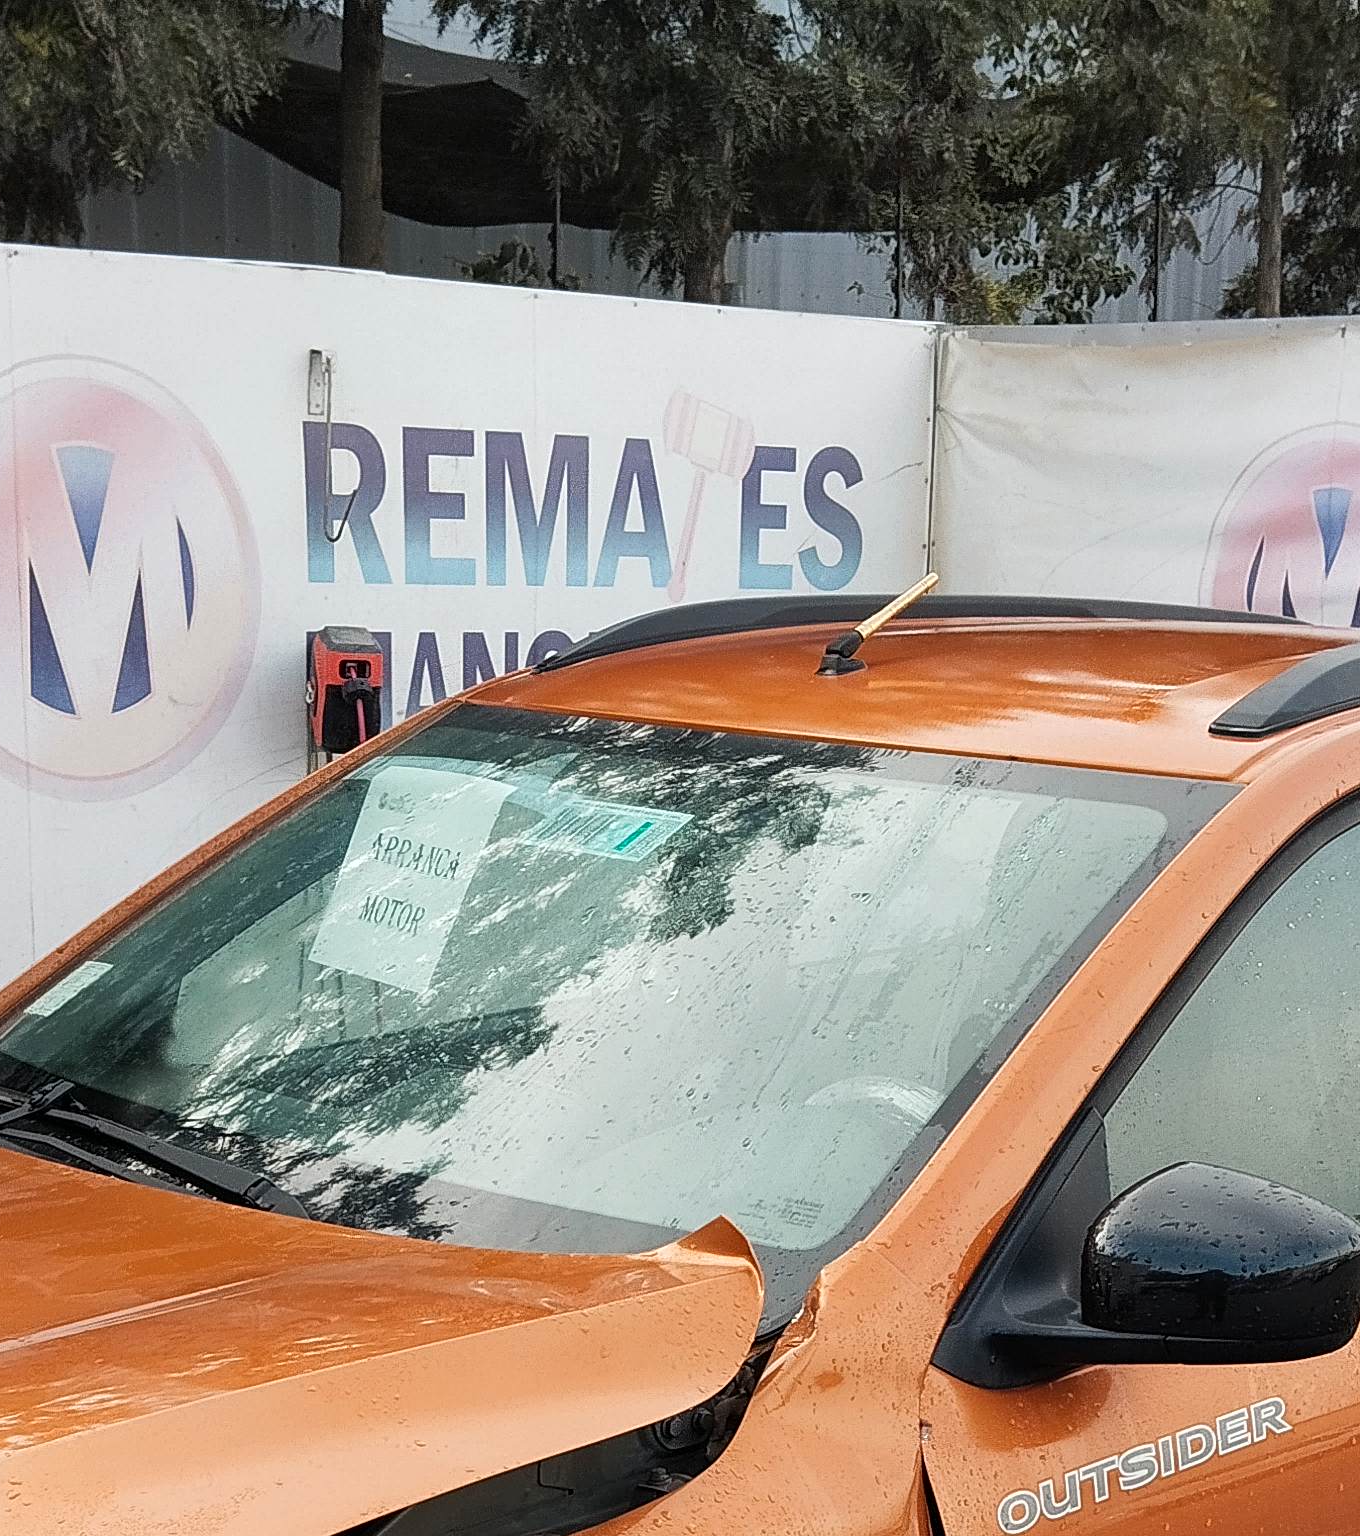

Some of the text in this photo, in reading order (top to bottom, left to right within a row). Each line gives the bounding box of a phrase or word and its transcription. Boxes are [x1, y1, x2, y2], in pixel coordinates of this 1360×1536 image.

[372, 832, 461, 880] ARRANCA
[358, 895, 426, 937] MOTOR
[996, 1397, 1292, 1535] OUTSIDER
